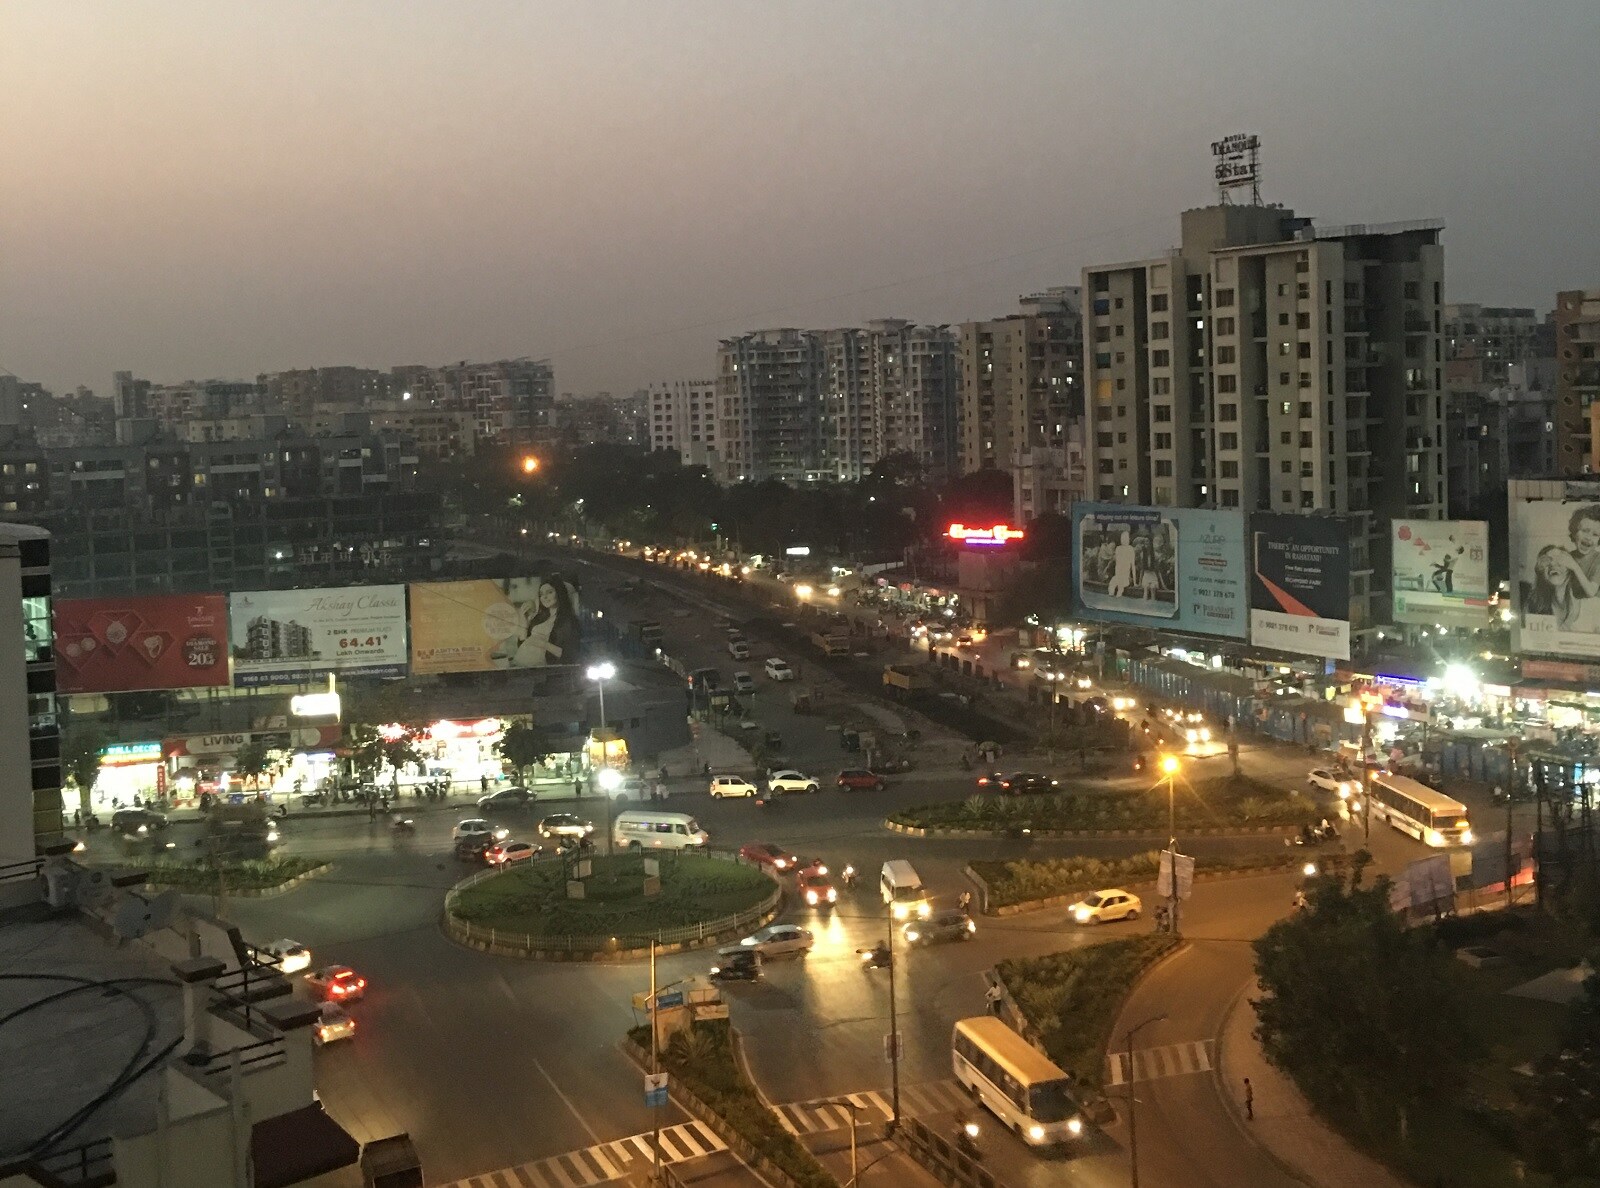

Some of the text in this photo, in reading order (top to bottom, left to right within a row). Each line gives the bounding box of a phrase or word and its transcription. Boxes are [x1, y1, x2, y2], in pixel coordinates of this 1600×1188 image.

[1300, 545, 1340, 555] OPPORTUNITY
[304, 595, 354, 617] Akshay
[354, 648, 385, 656] Onwards
[203, 735, 244, 747] LIVING
